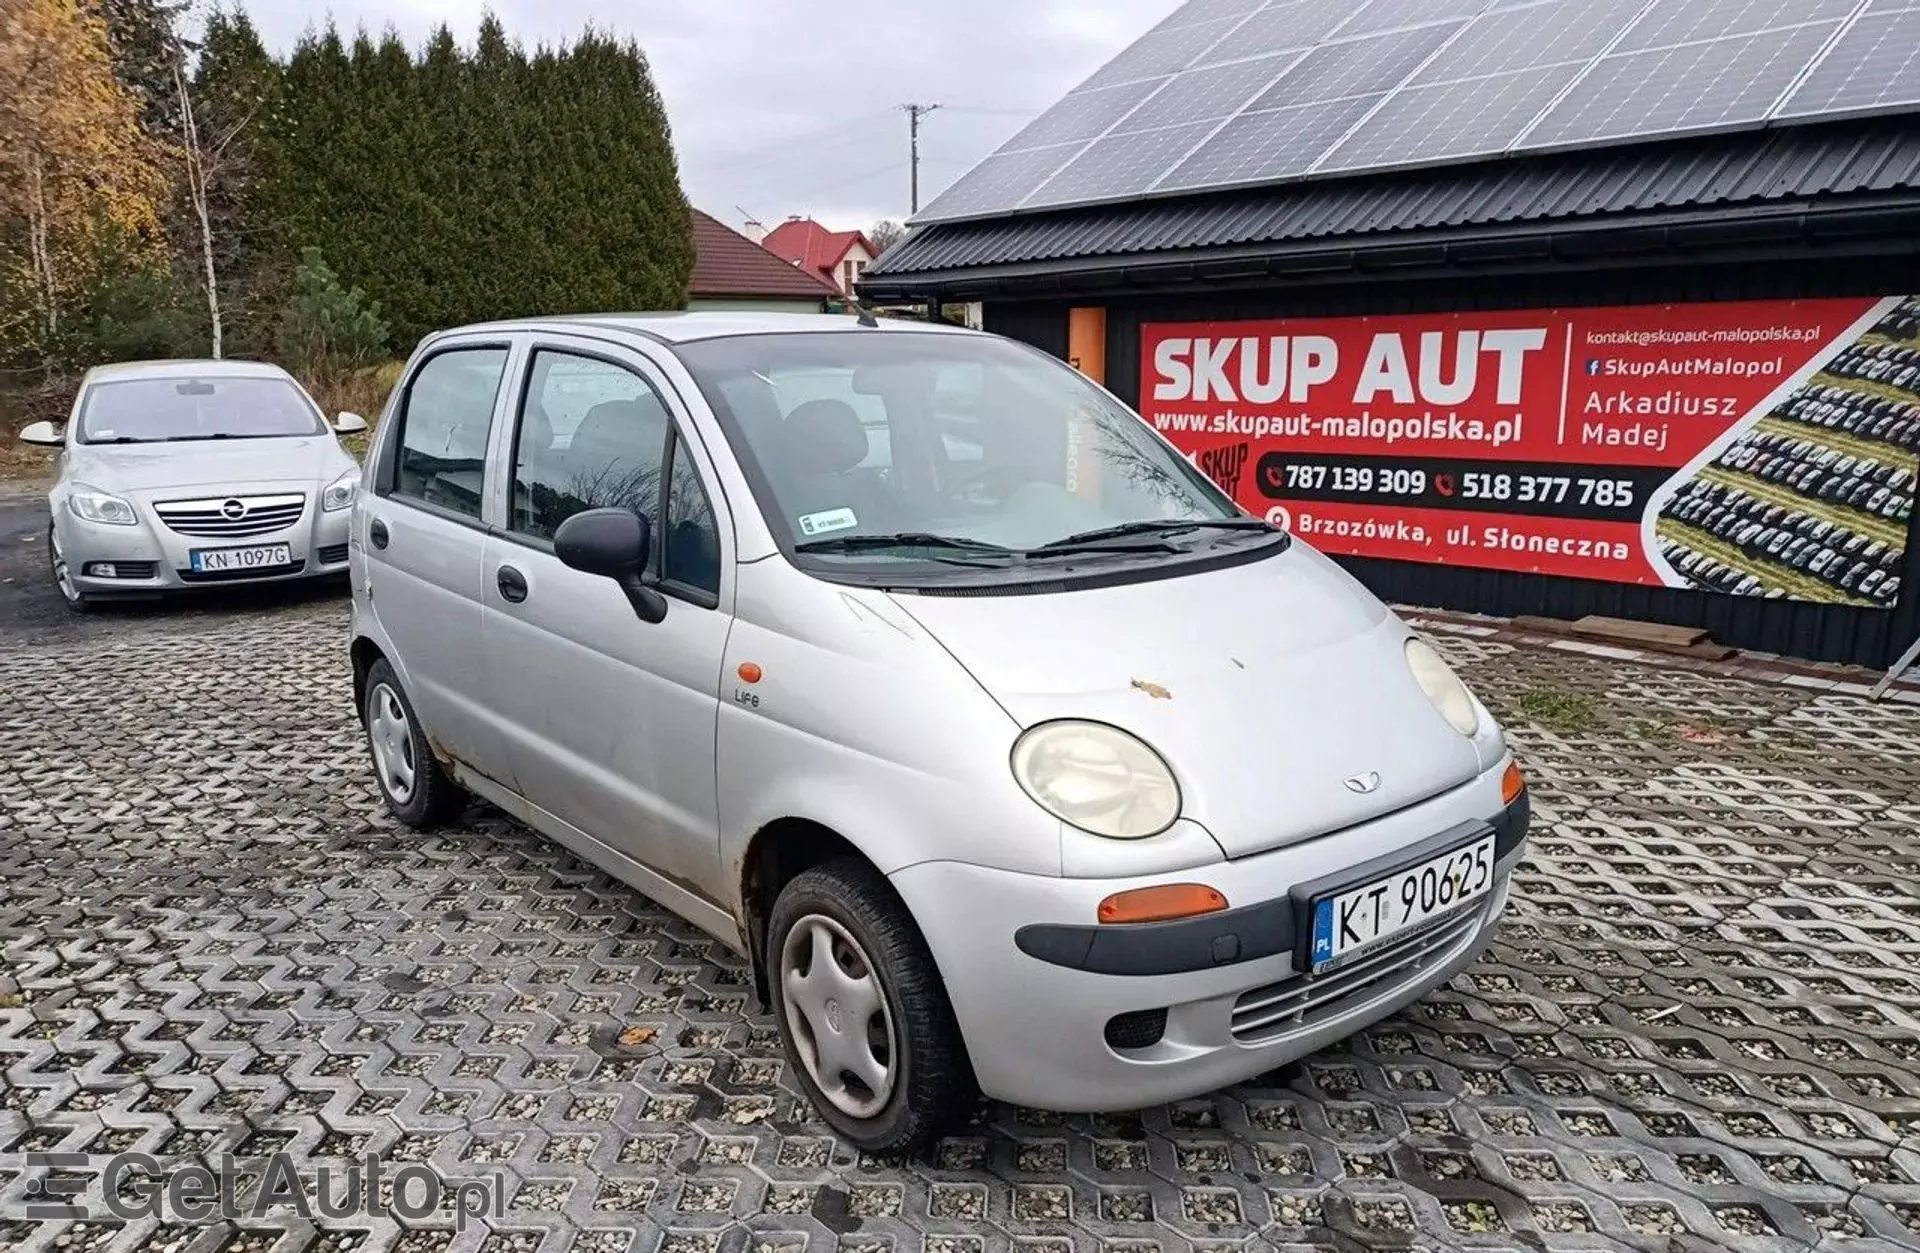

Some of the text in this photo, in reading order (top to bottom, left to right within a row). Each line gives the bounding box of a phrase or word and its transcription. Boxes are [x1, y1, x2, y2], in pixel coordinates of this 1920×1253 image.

[1586, 325, 1821, 346] kontakt@skupaut-malopolska.pl
[1153, 328, 1548, 406] SKUP AUT
[1603, 357, 1783, 378] SkupAutMalopol
[1583, 391, 1738, 417] Arkadiusz
[1153, 409, 1523, 446] www.skupaut-malopolska.pl
[1582, 423, 1669, 452] Madej
[1202, 442, 1249, 482] SKUP
[1285, 464, 1427, 495] 787 139 309
[1462, 473, 1634, 508] 518 377 785
[1299, 513, 1630, 560] Brzozówka, ul. Słoneczna
[204, 547, 287, 569] KN 1097G
[1316, 940, 1330, 954] PL
[1339, 884, 1389, 950] KT
[1400, 842, 1490, 925] 90625
